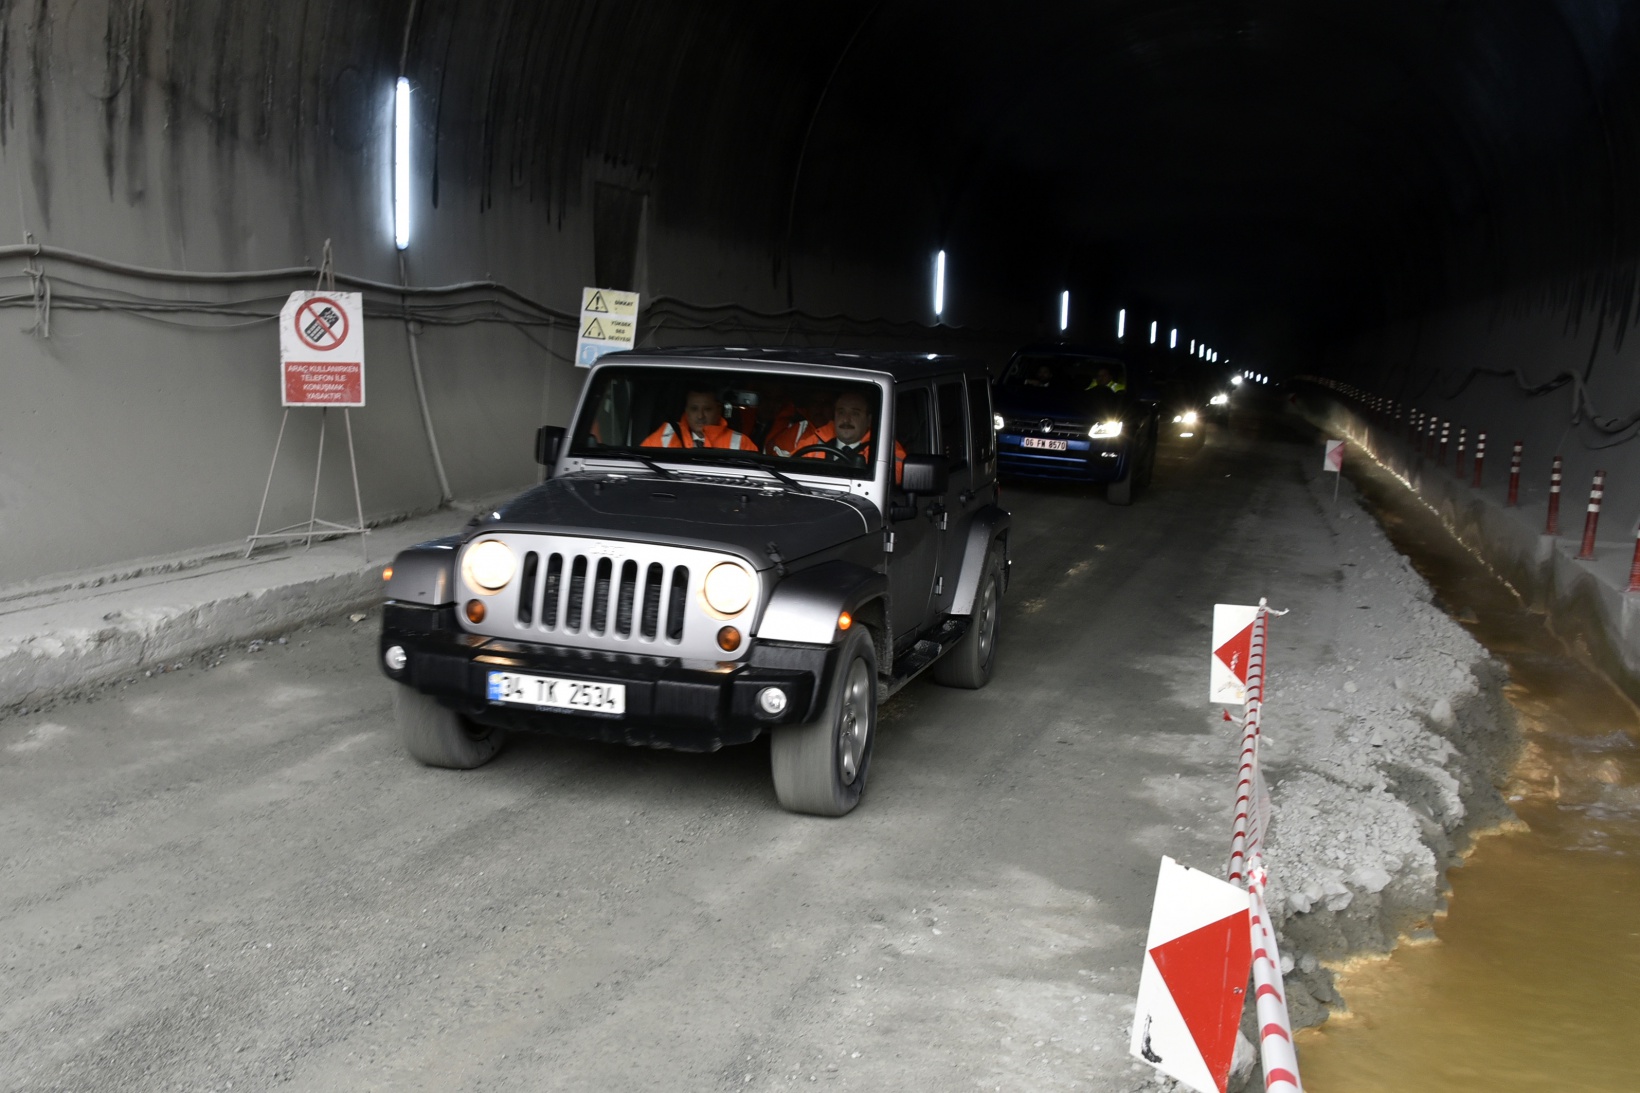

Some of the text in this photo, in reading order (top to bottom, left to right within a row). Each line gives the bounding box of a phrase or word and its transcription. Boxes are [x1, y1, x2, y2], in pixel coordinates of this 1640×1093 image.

[287, 365, 308, 373] ARAÇ
[303, 383, 345, 391] KONUŞMAK
[306, 392, 342, 400] YASAKTIR
[1025, 438, 1034, 446] 06
[1048, 440, 1066, 450] 8570
[502, 675, 616, 710] 34 TK 2534
